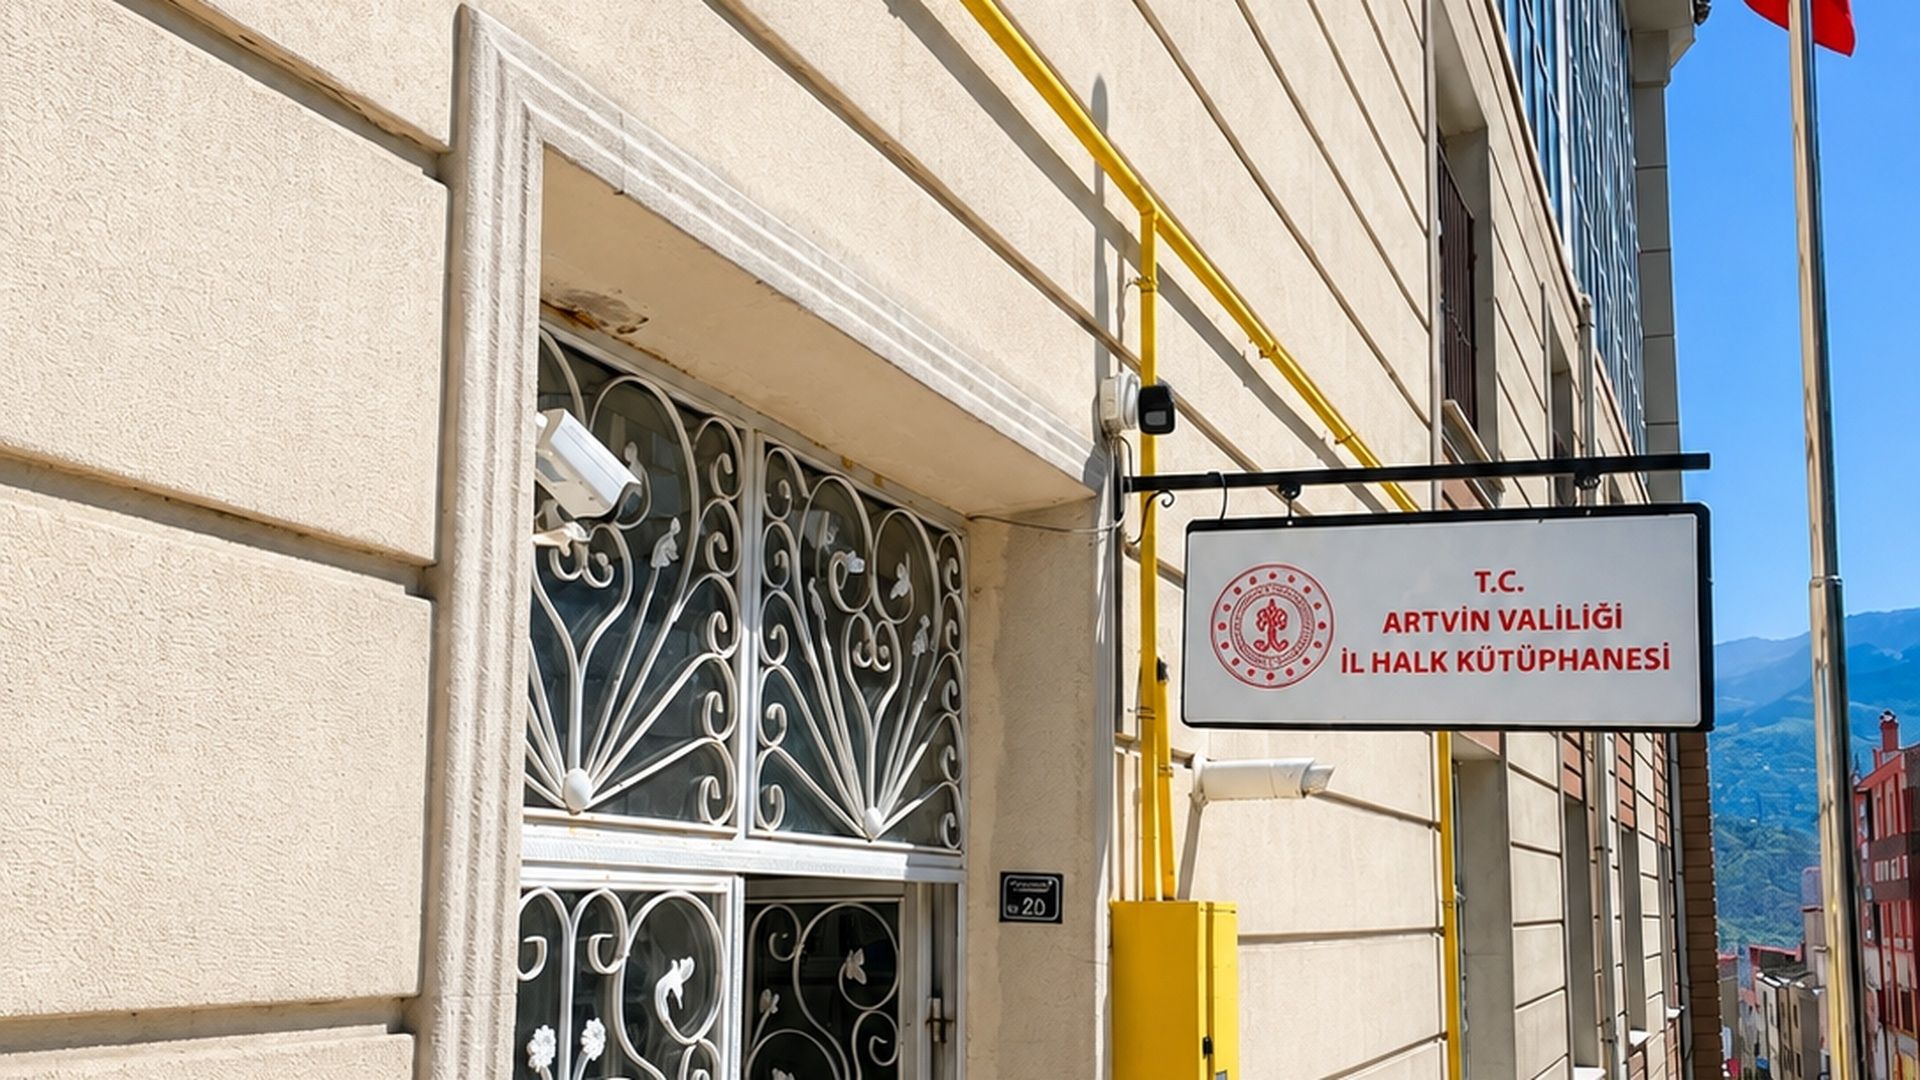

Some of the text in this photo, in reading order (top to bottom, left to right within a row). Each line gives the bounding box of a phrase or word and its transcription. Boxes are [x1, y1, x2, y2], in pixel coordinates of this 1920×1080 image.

[1474, 570, 1524, 593] T.C.
[1383, 602, 1623, 634] ARTVİN VALİLİĞİ
[1341, 642, 1671, 674] İL HALK KÜTÜPHANESİ
[1022, 897, 1046, 916] 20
